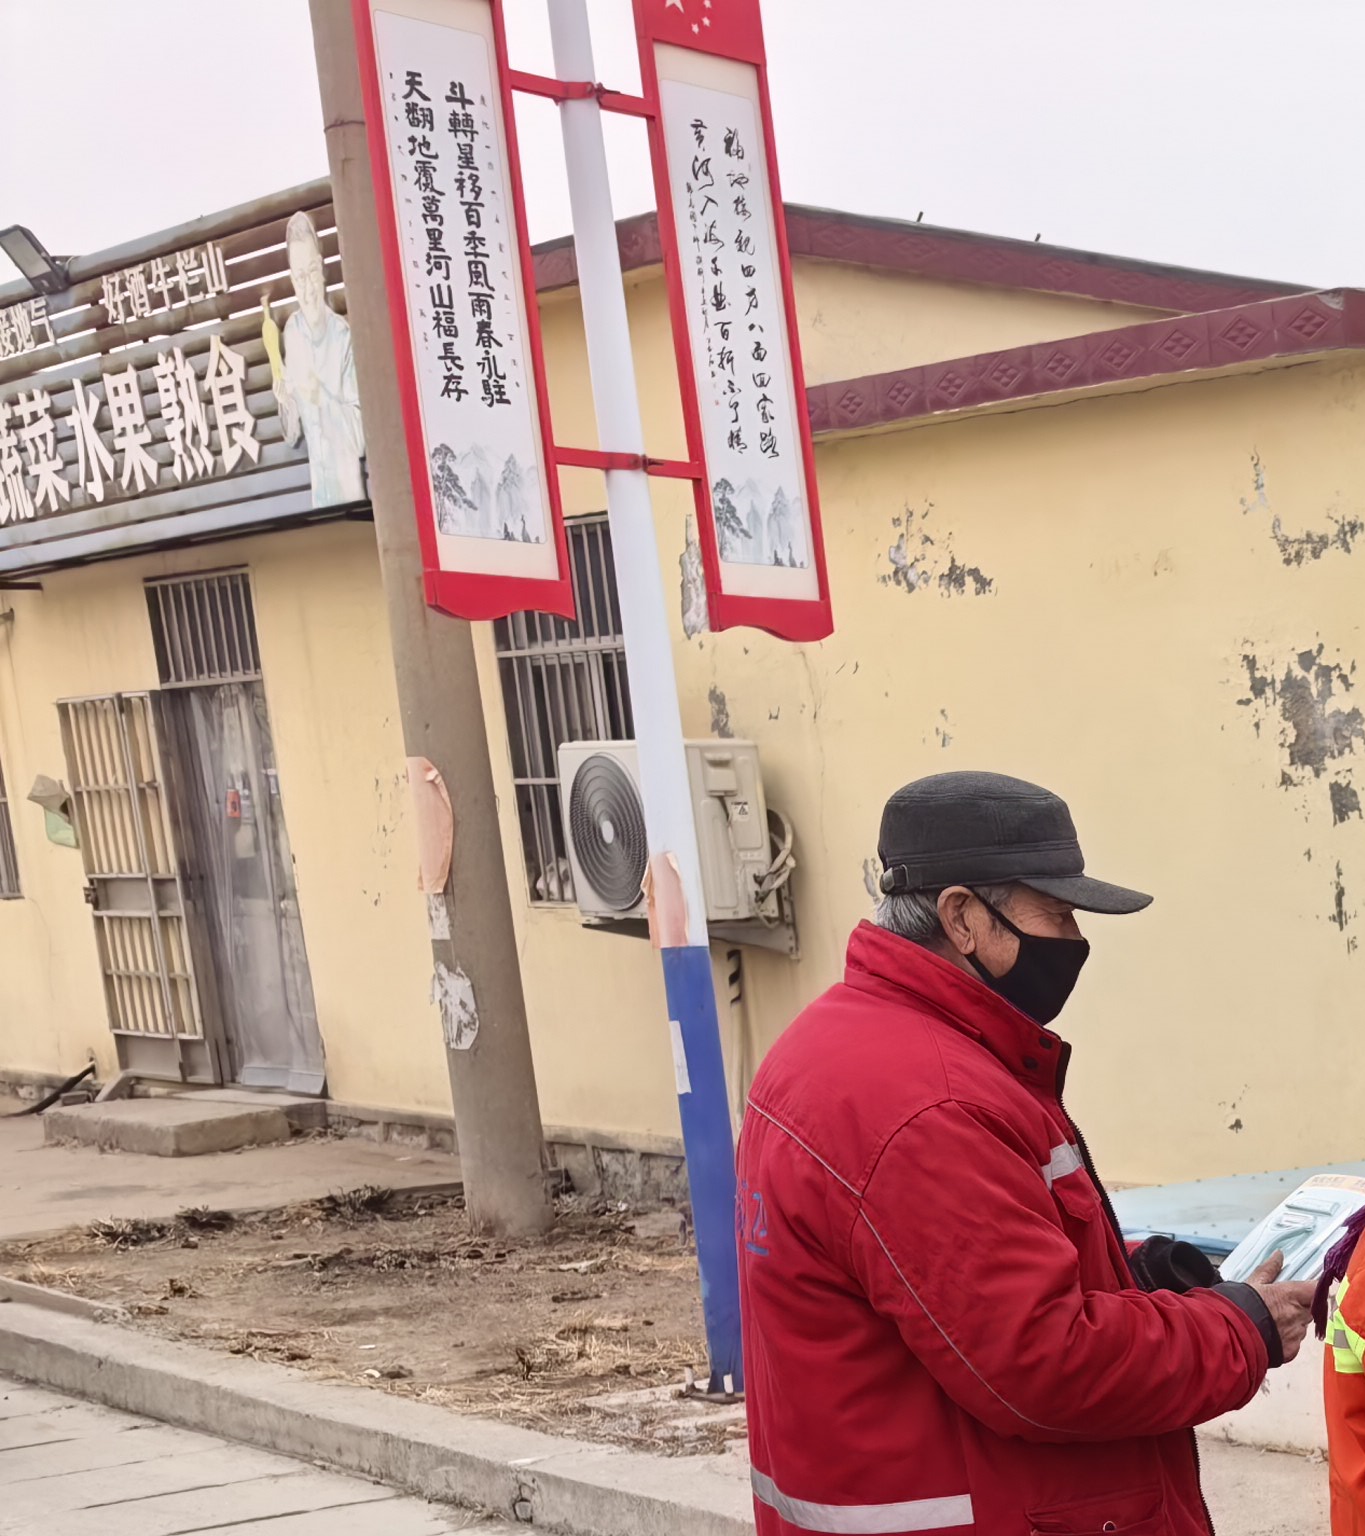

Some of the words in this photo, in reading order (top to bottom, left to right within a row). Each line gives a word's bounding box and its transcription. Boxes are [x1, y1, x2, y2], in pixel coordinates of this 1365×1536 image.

[101, 241, 229, 325] 好酒牛栏山
